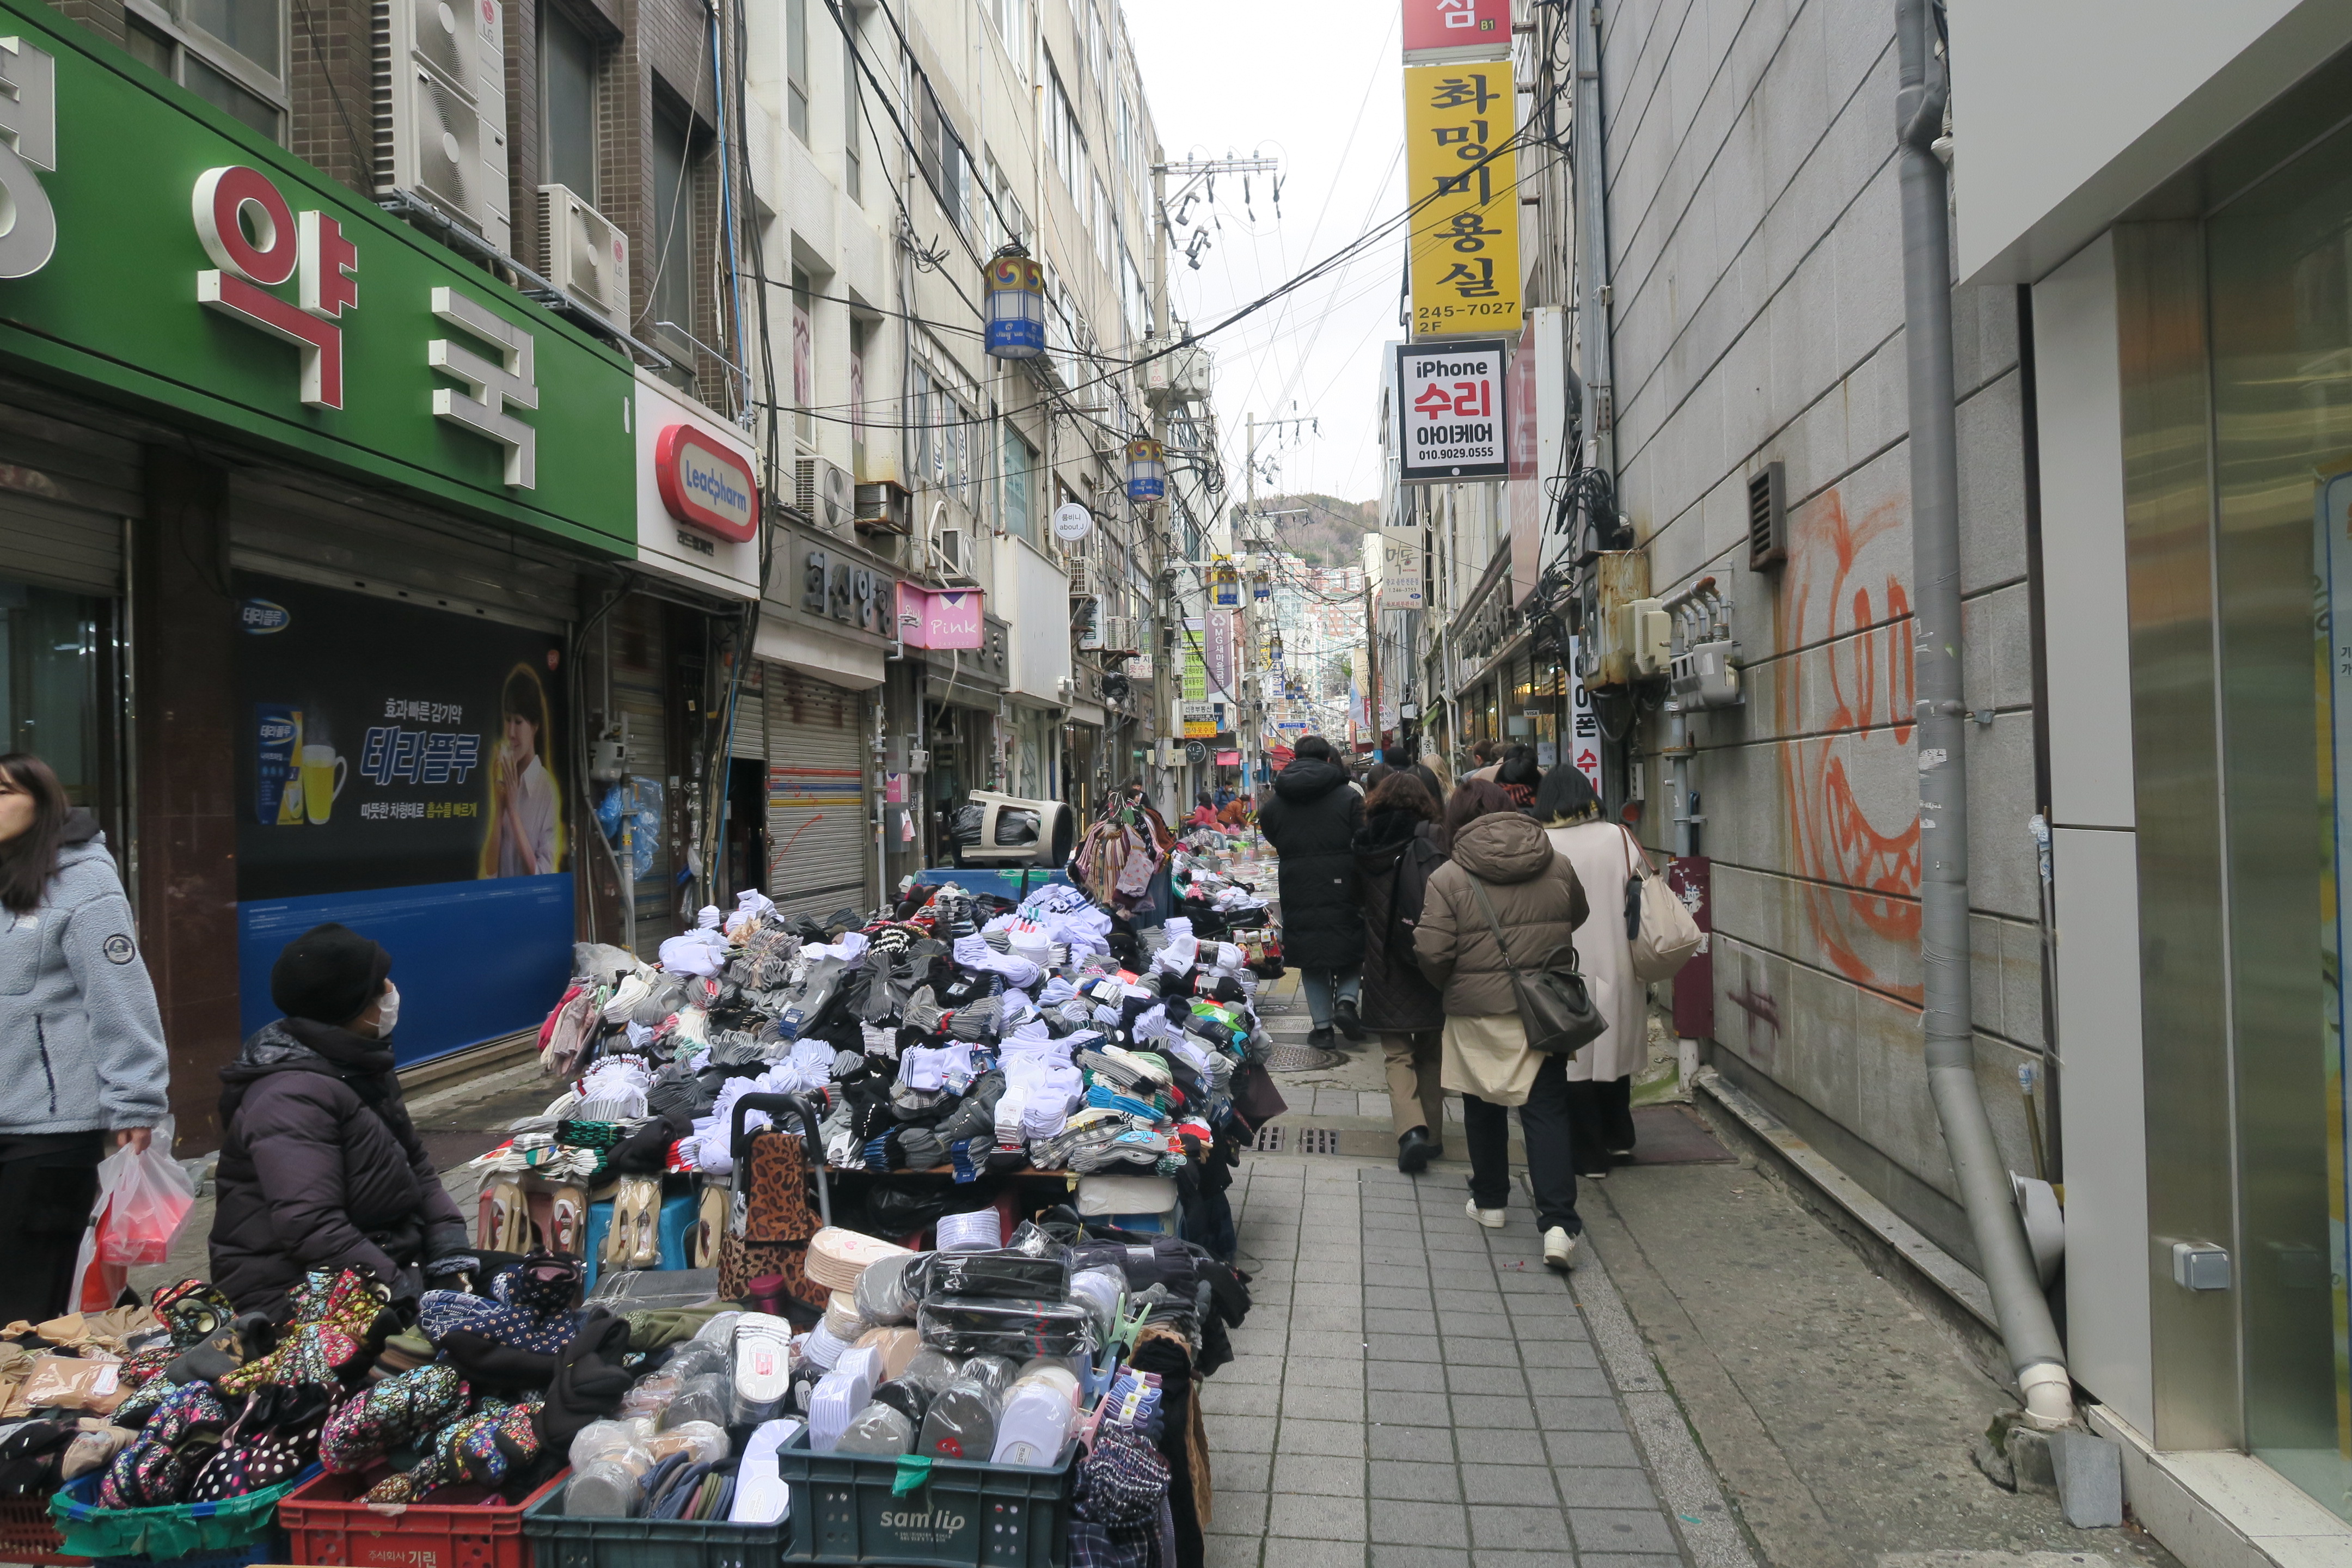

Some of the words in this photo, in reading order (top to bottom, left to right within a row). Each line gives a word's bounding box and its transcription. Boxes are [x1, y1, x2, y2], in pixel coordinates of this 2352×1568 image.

[1480, 20, 1495, 30] B1
[1419, 302, 1515, 318] 245-7027
[192, 166, 539, 491] 약국
[1419, 321, 1442, 332] 2F
[1417, 360, 1487, 378] iPhone
[1414, 379, 1491, 420] 수리
[1417, 422, 1493, 445] 아이케어
[1419, 447, 1493, 460] 010.9029.0555
[686, 460, 746, 513] Leadpharm
[808, 551, 893, 634] 화신양행
[243, 607, 282, 626] 테라플루
[930, 619, 977, 635] Pink
[384, 698, 408, 720] 효과
[408, 701, 430, 721] 빠른
[431, 703, 462, 724] 감기약
[260, 725, 291, 737] 테라플루
[360, 725, 480, 786] 테라플루
[361, 803, 389, 819] 따뜻한
[390, 802, 425, 819] 차형태로
[427, 802, 451, 818] 흡수를
[453, 802, 478, 817] 빠르게
[369, 1551, 405, 1561] 주식회사
[408, 1551, 437, 1568] 기린
